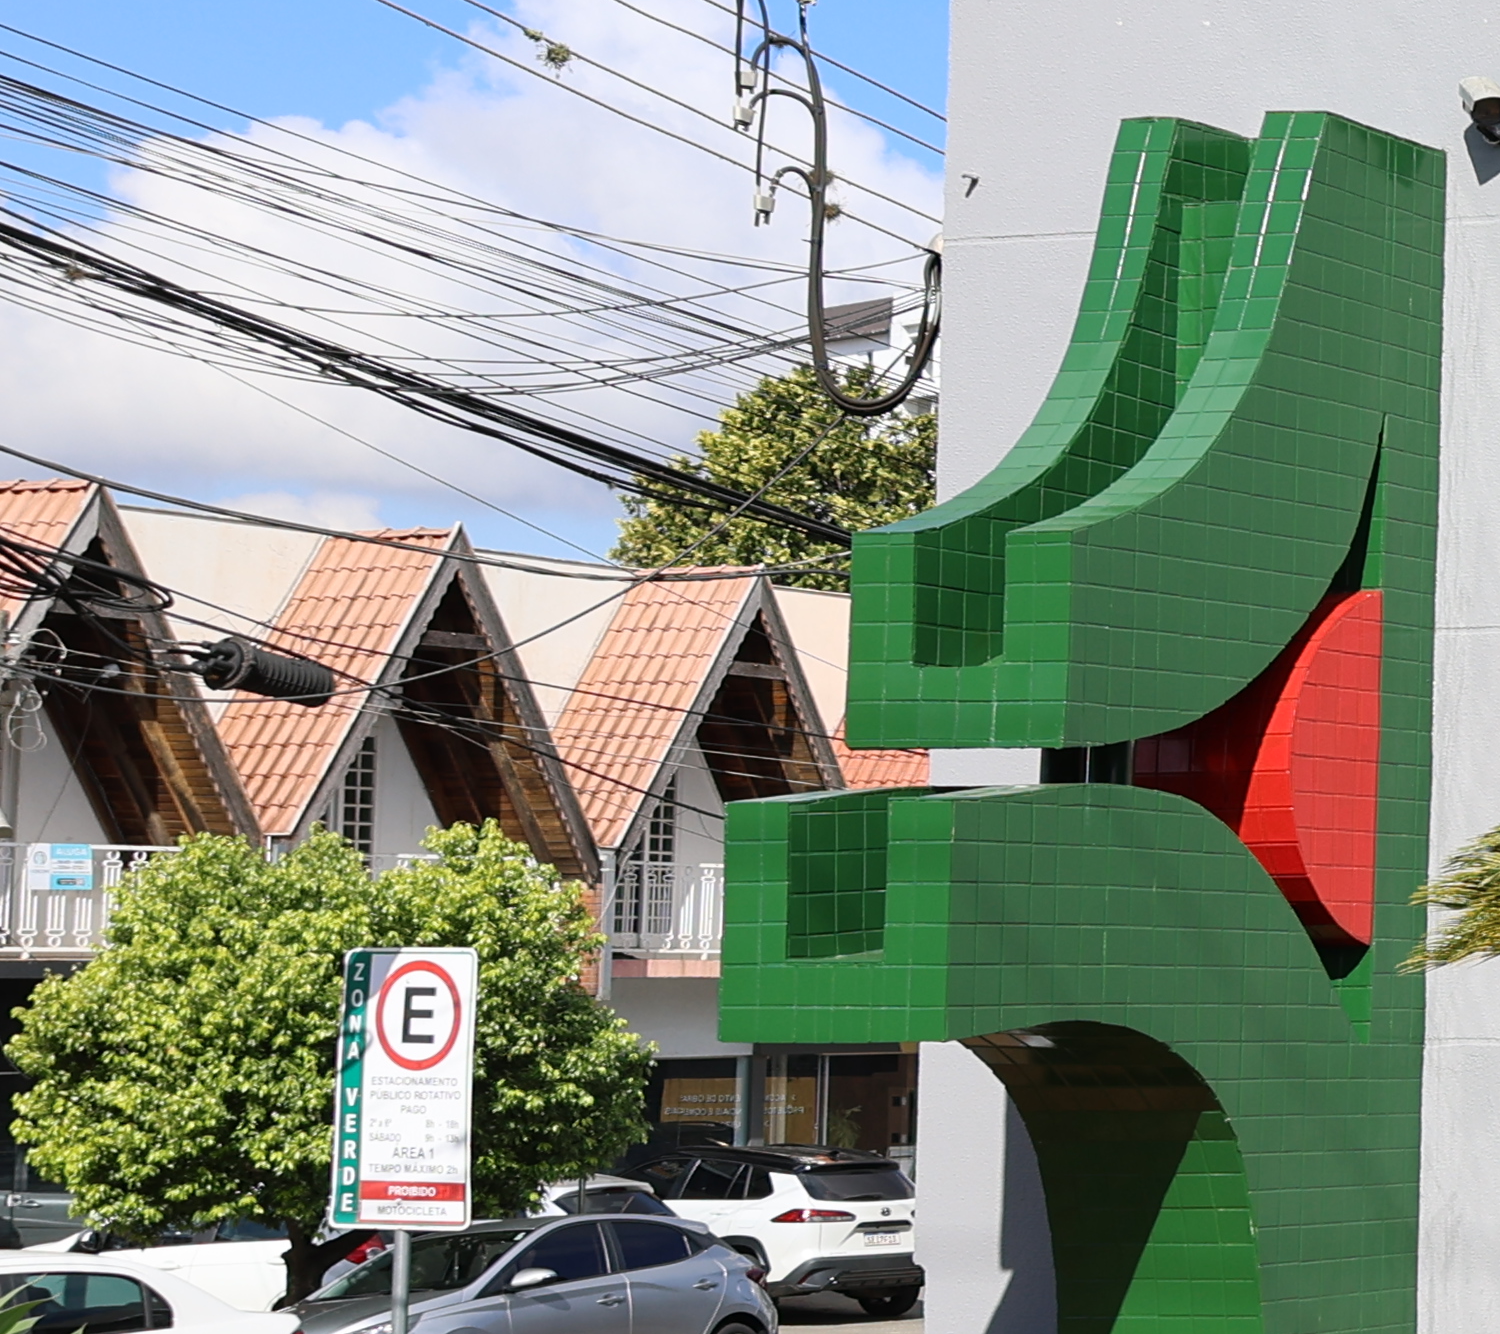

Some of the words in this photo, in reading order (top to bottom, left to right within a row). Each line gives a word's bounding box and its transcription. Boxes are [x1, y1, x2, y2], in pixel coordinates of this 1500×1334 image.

[348, 963, 364, 1059] ZONA
[401, 986, 437, 1044] E
[371, 1076, 458, 1087] ESTACIONAMENTO
[370, 1088, 411, 1100] PÚBLICO
[414, 1090, 461, 1100] ROTATIVO
[400, 1105, 427, 1115] PAGO
[425, 1119, 435, 1128] 8h
[446, 1120, 459, 1129] 18h
[369, 1130, 401, 1142] SÁBADO
[425, 1133, 434, 1142] 9h
[446, 1134, 459, 1143] 13h
[341, 1088, 359, 1212] VERDE
[392, 1143, 425, 1159] ÁREA
[429, 1148, 434, 1159] 1
[369, 1163, 401, 1173] TEMPO
[404, 1162, 444, 1174] MÁXIMO
[446, 1165, 458, 1175] 2h
[388, 1185, 436, 1197] PROIBIDO
[377, 1205, 447, 1216] MOTOCICLETA
